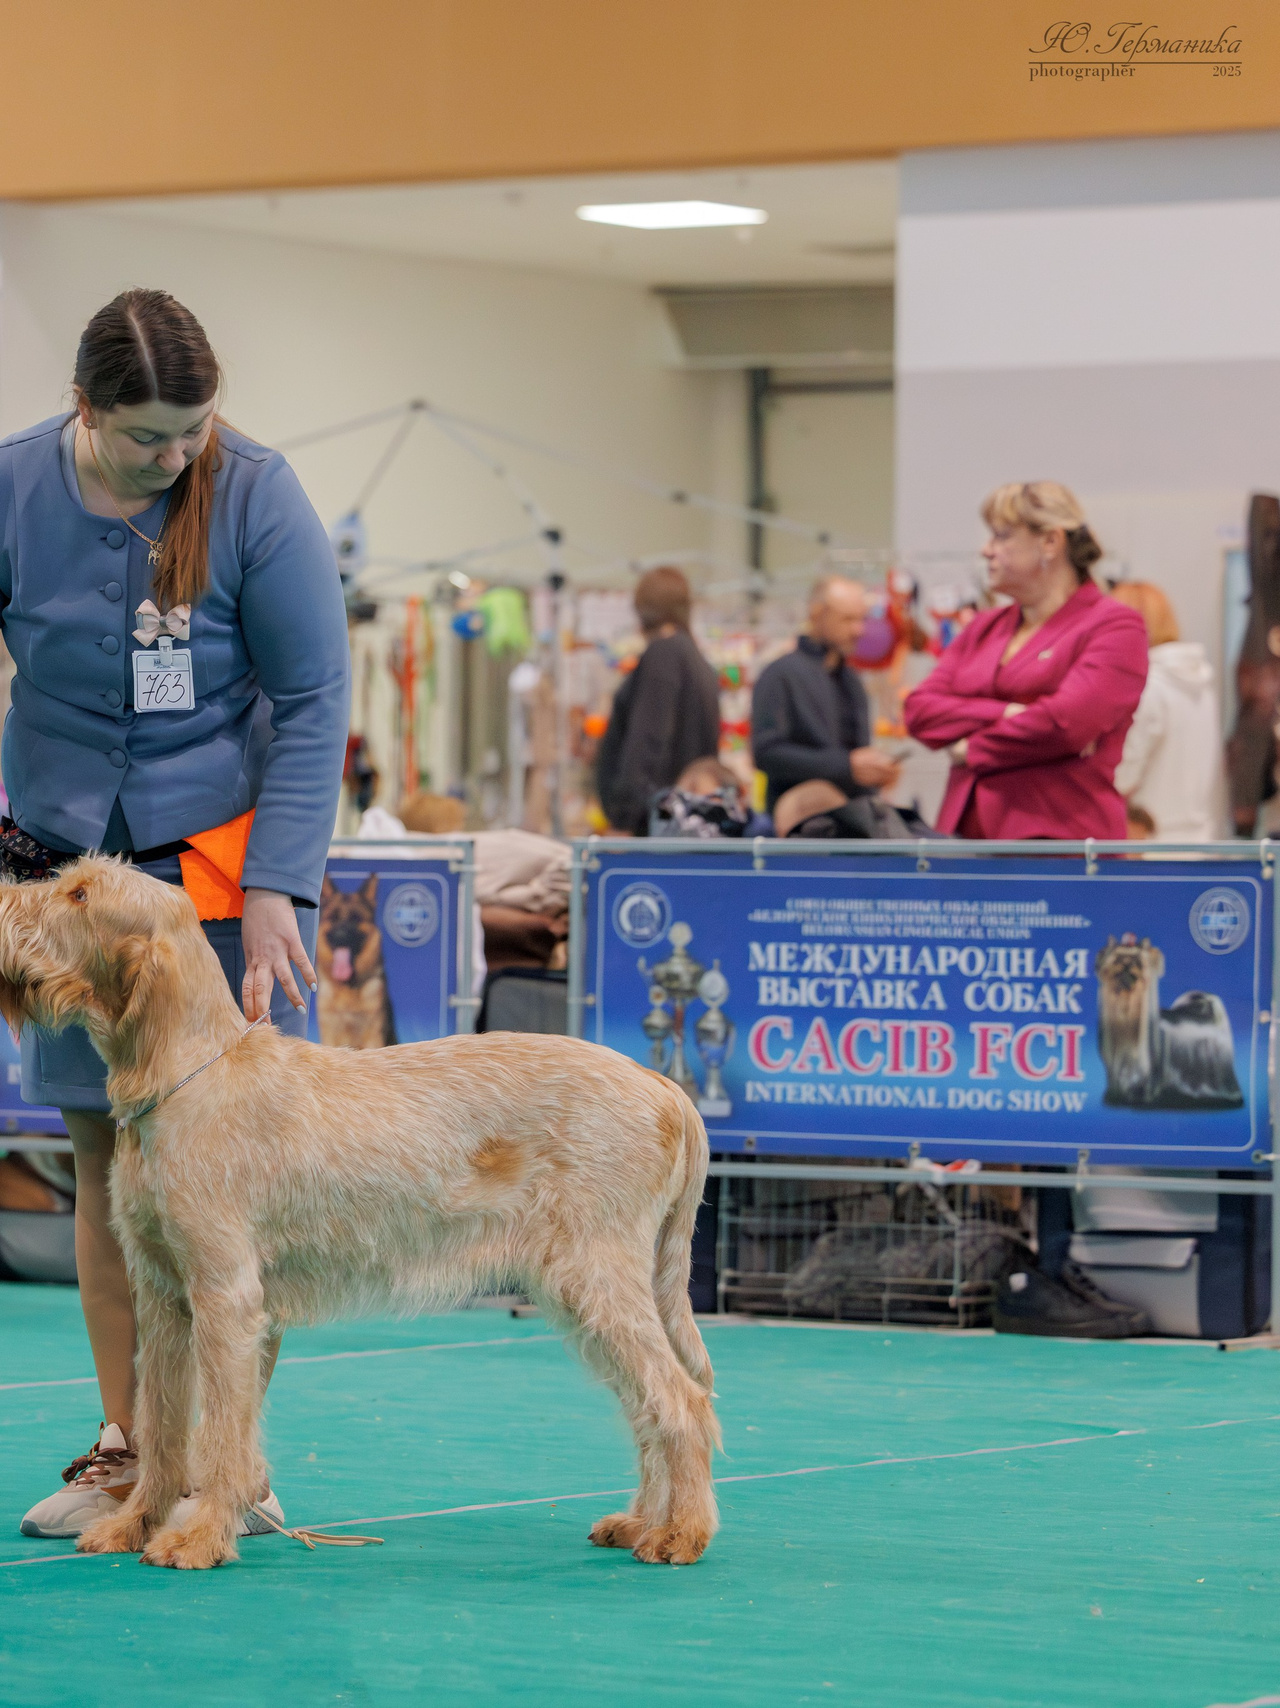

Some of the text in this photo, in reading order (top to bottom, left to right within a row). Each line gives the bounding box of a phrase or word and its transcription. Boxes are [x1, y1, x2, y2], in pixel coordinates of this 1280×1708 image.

[142, 673, 185, 706] 763
[748, 942, 1090, 981] МЕЖДУНАРОДНАЯ
[757, 976, 1083, 1014] ВЫСТАВКА СОБАК
[748, 1015, 1086, 1082] CACIB FCI
[745, 1080, 1088, 1114] INTERNATIONAL DOG SHOW
